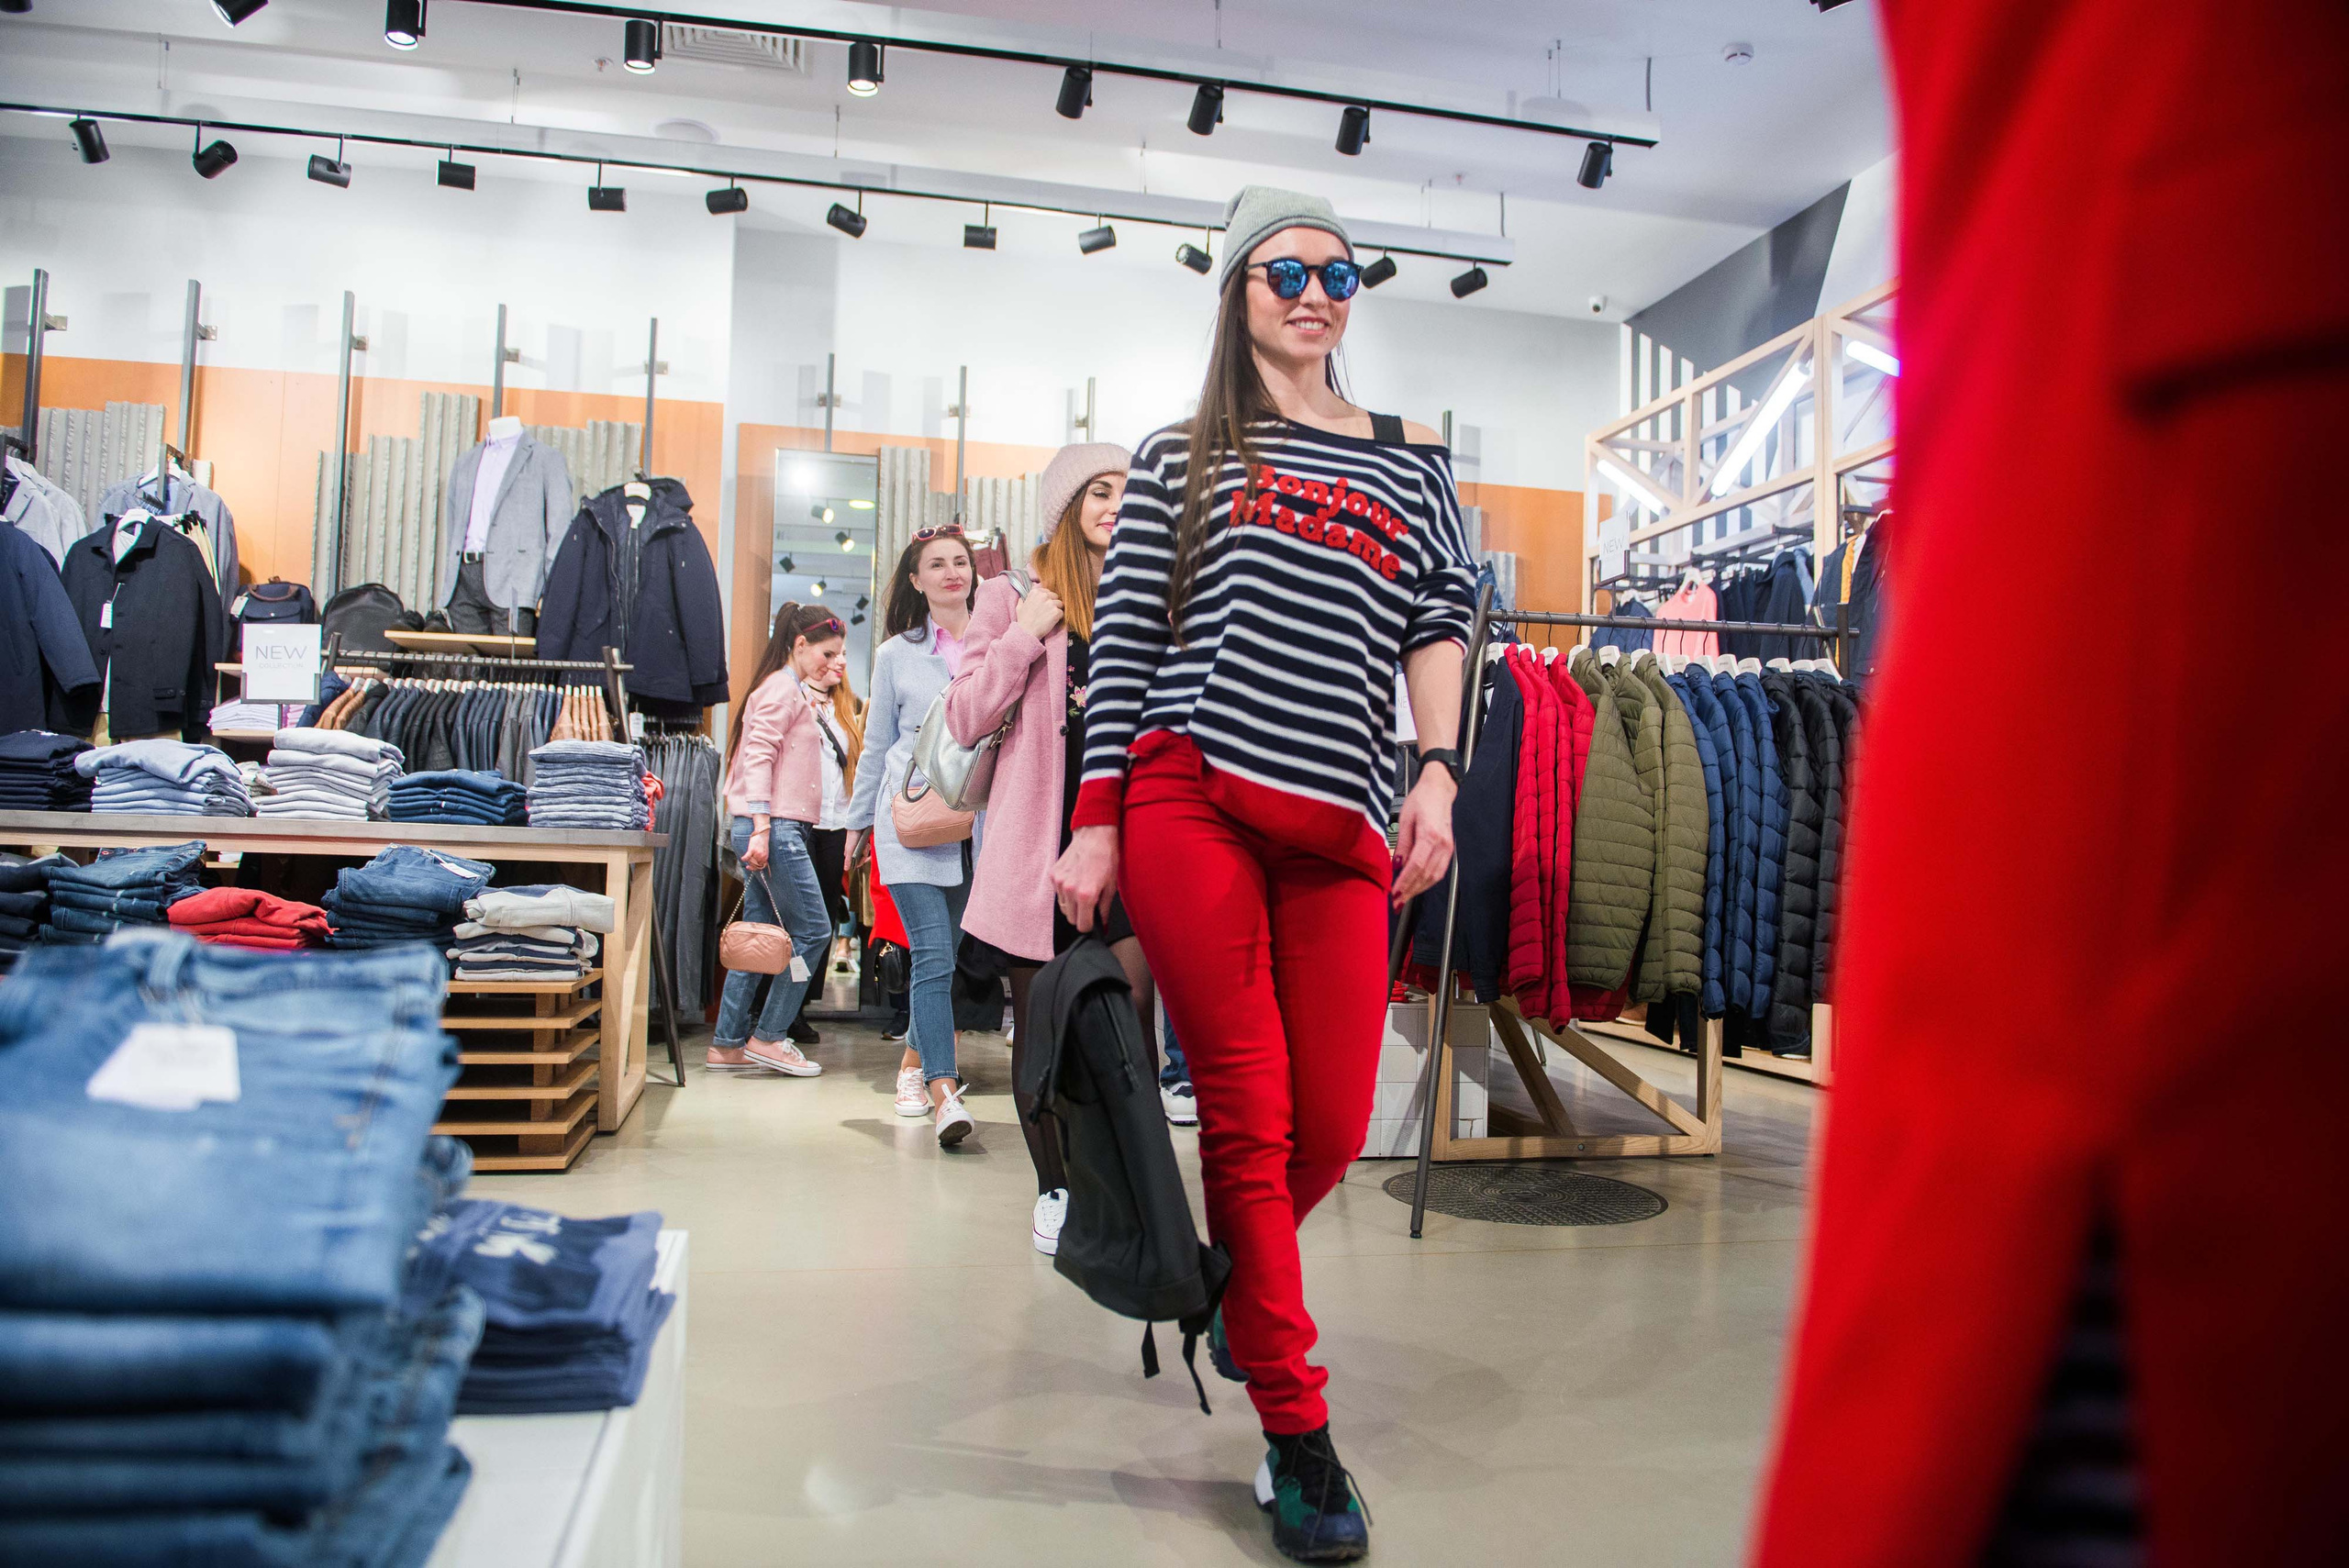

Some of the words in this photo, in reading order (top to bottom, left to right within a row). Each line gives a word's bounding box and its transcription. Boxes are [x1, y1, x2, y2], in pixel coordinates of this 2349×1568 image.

[1243, 463, 1409, 542] Bonjour
[1229, 490, 1402, 581] Madame
[1603, 536, 1625, 554] NEW
[255, 645, 308, 660] NEW
[1397, 695, 1408, 709] NE
